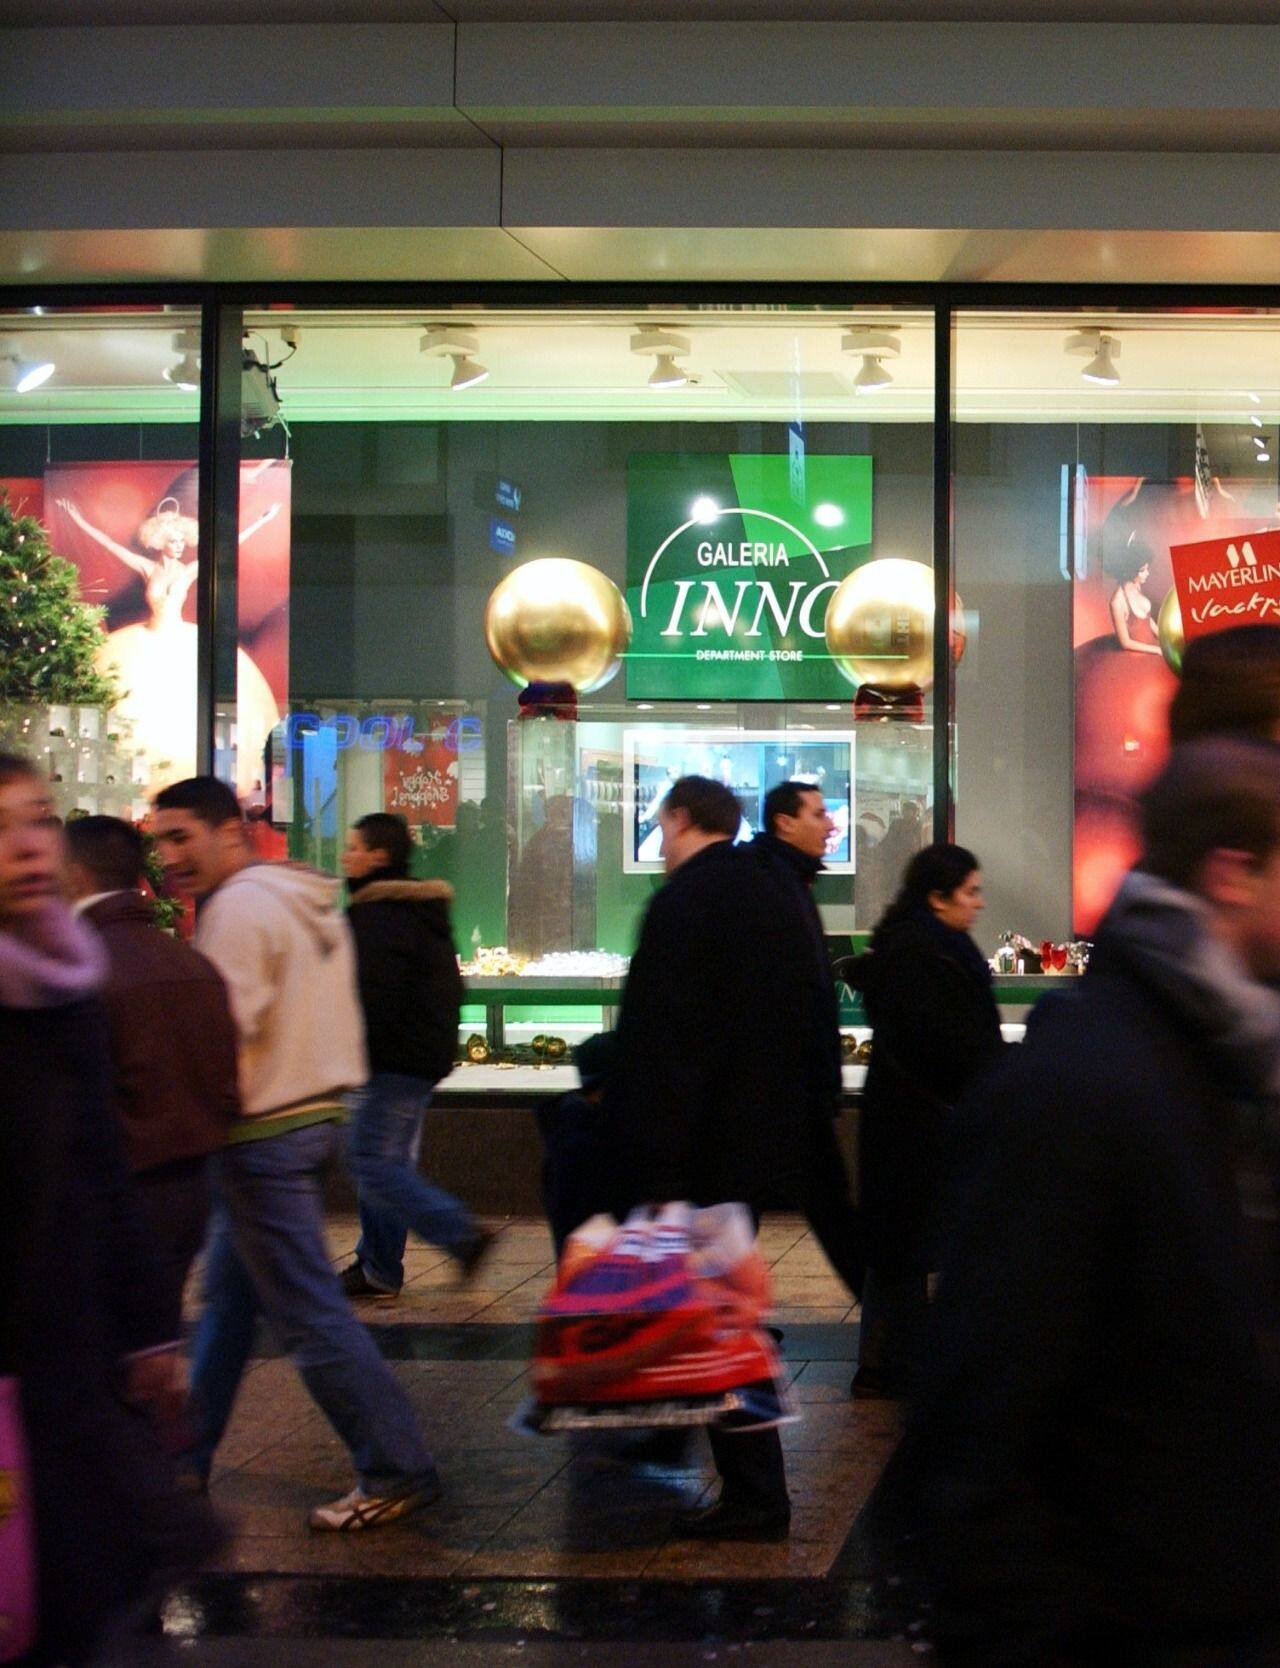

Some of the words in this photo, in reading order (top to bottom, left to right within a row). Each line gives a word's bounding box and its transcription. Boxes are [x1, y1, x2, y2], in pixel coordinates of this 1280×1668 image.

[697, 542, 789, 566] GALERIA
[696, 650, 766, 661] DEPARTMENT
[768, 650, 803, 661] STORE
